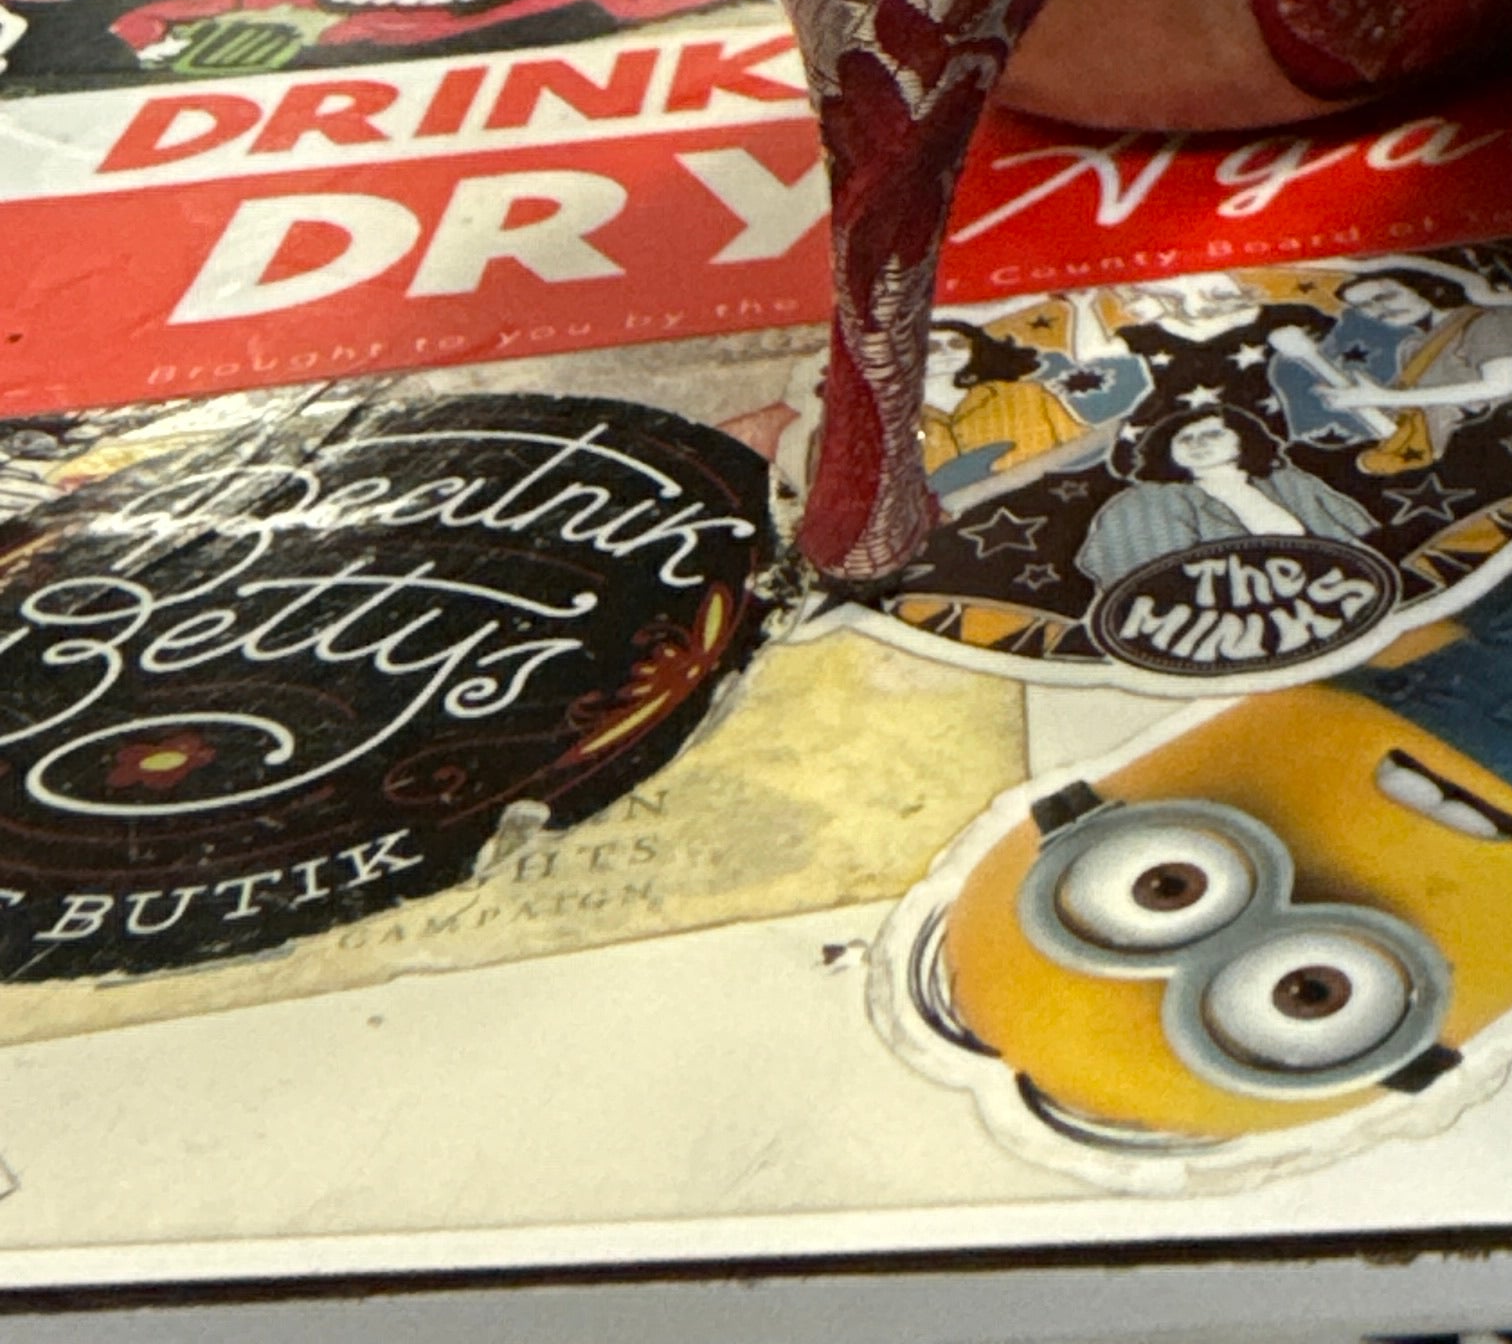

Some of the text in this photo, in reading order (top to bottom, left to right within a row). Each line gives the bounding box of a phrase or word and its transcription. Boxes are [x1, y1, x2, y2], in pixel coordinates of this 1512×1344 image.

[95, 34, 814, 175] DRINK
[168, 147, 832, 326] DRY
[990, 244, 1182, 288] County
[1206, 222, 1363, 260] Board
[1388, 219, 1437, 243] of
[146, 294, 799, 387] Brought to you by the
[92, 422, 756, 602] Beatnik
[1120, 566, 1380, 662] MINKS
[33, 828, 425, 942] BUTIK
